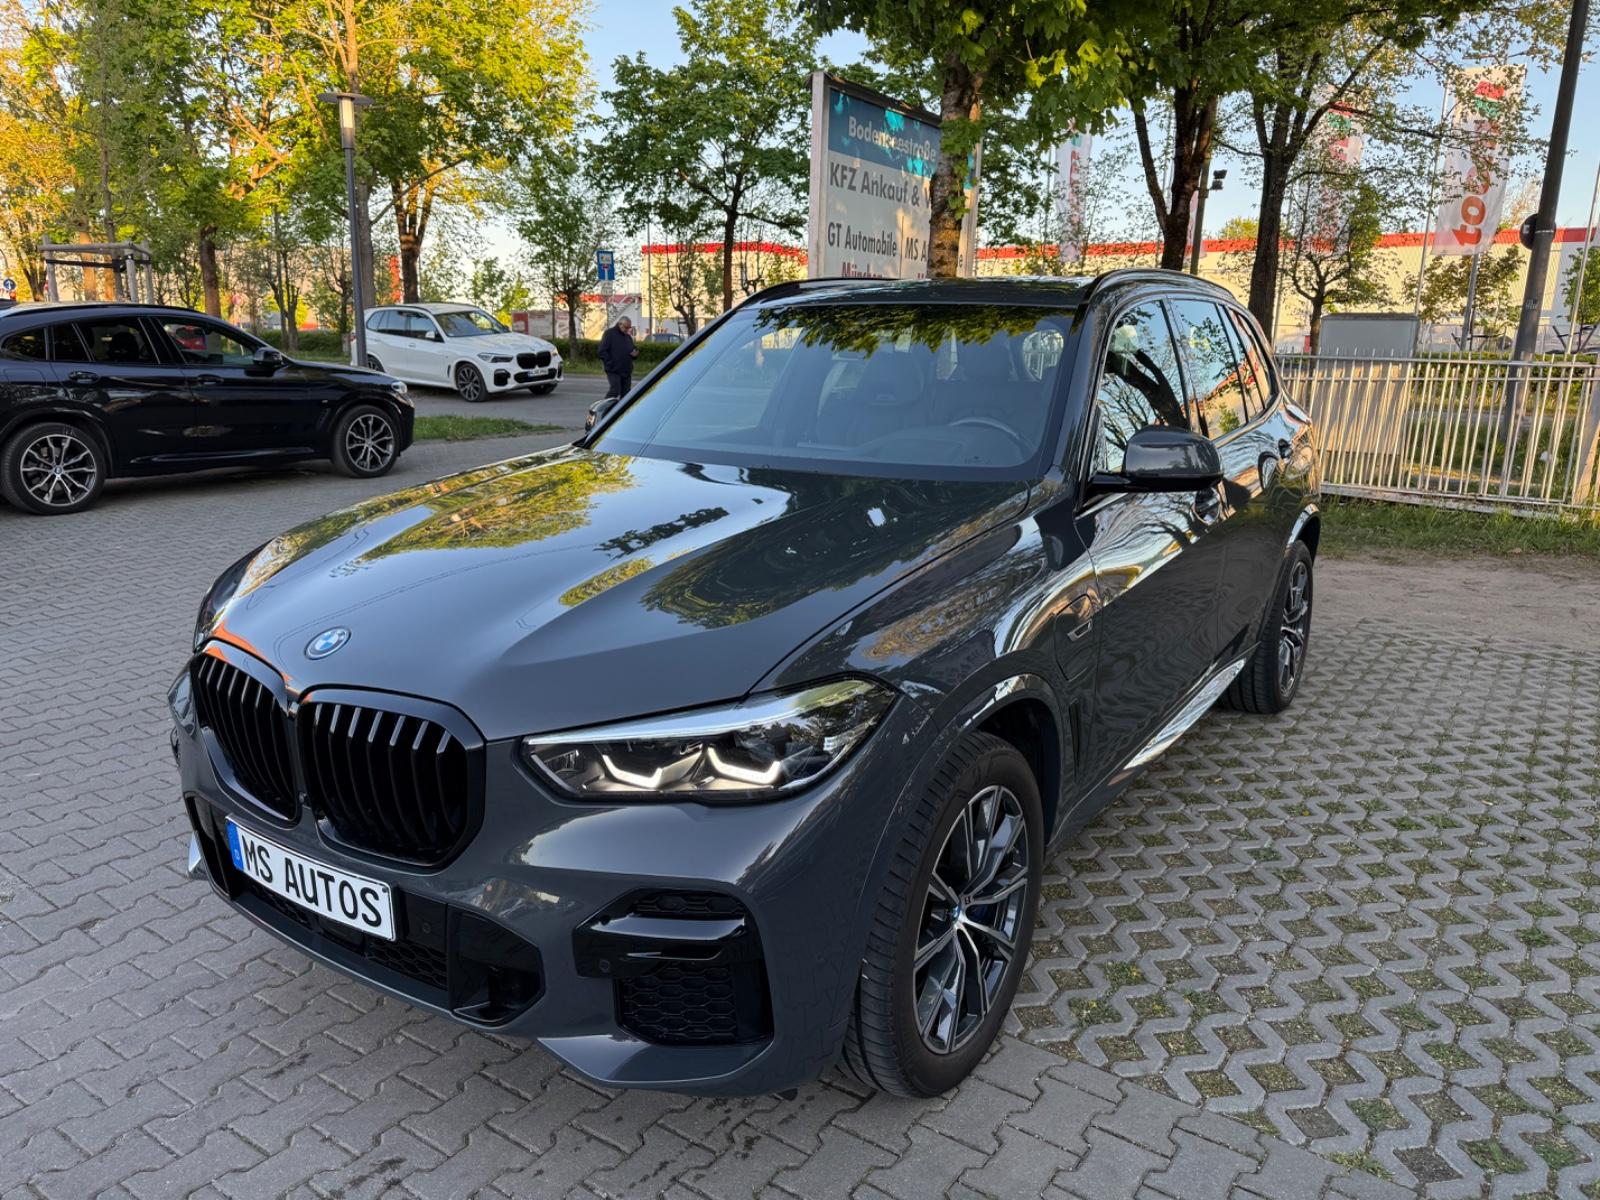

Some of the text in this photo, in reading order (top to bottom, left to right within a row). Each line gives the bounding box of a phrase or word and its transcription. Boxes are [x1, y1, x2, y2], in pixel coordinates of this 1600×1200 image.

[848, 116, 937, 162] Bodenseestraße
[829, 162, 857, 192] KFZ
[860, 170, 909, 204] Ankauf
[911, 185, 921, 208] &
[827, 222, 842, 249] GT
[844, 224, 897, 258] Automobile
[904, 237, 919, 261] MS
[241, 834, 382, 928] MS AUTOS
